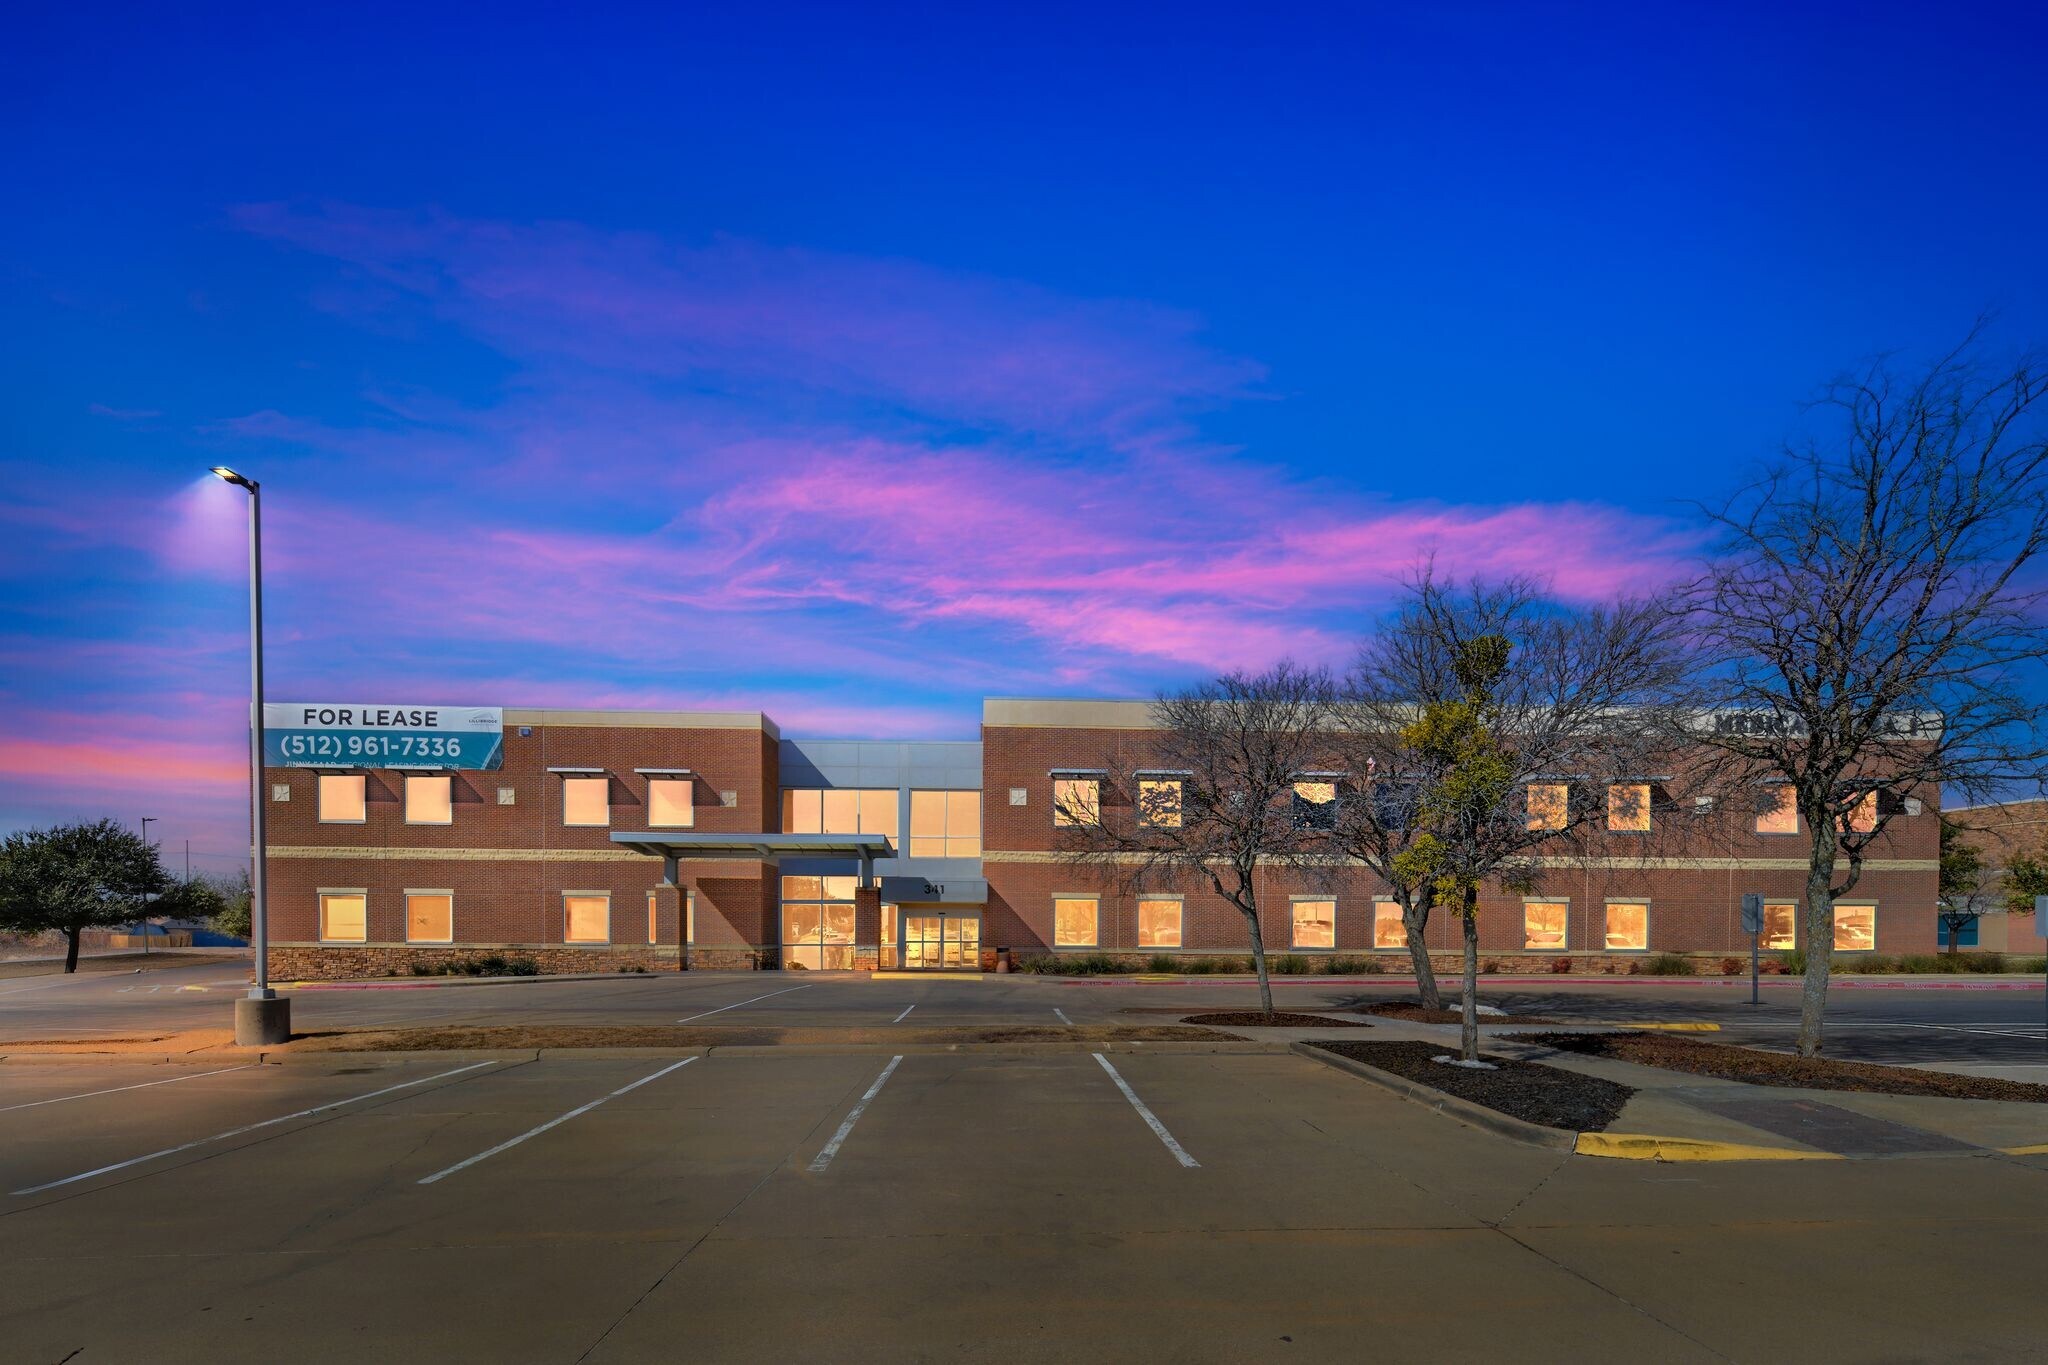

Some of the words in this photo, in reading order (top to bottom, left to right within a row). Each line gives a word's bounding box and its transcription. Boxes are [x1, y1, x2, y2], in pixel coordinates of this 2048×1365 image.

[303, 708, 353, 726] FOR
[362, 709, 438, 727] LEASE
[1715, 713, 1820, 736] MEDICA
[280, 734, 342, 758] (512)
[348, 735, 461, 757] 961-7336
[924, 884, 945, 895] 341
